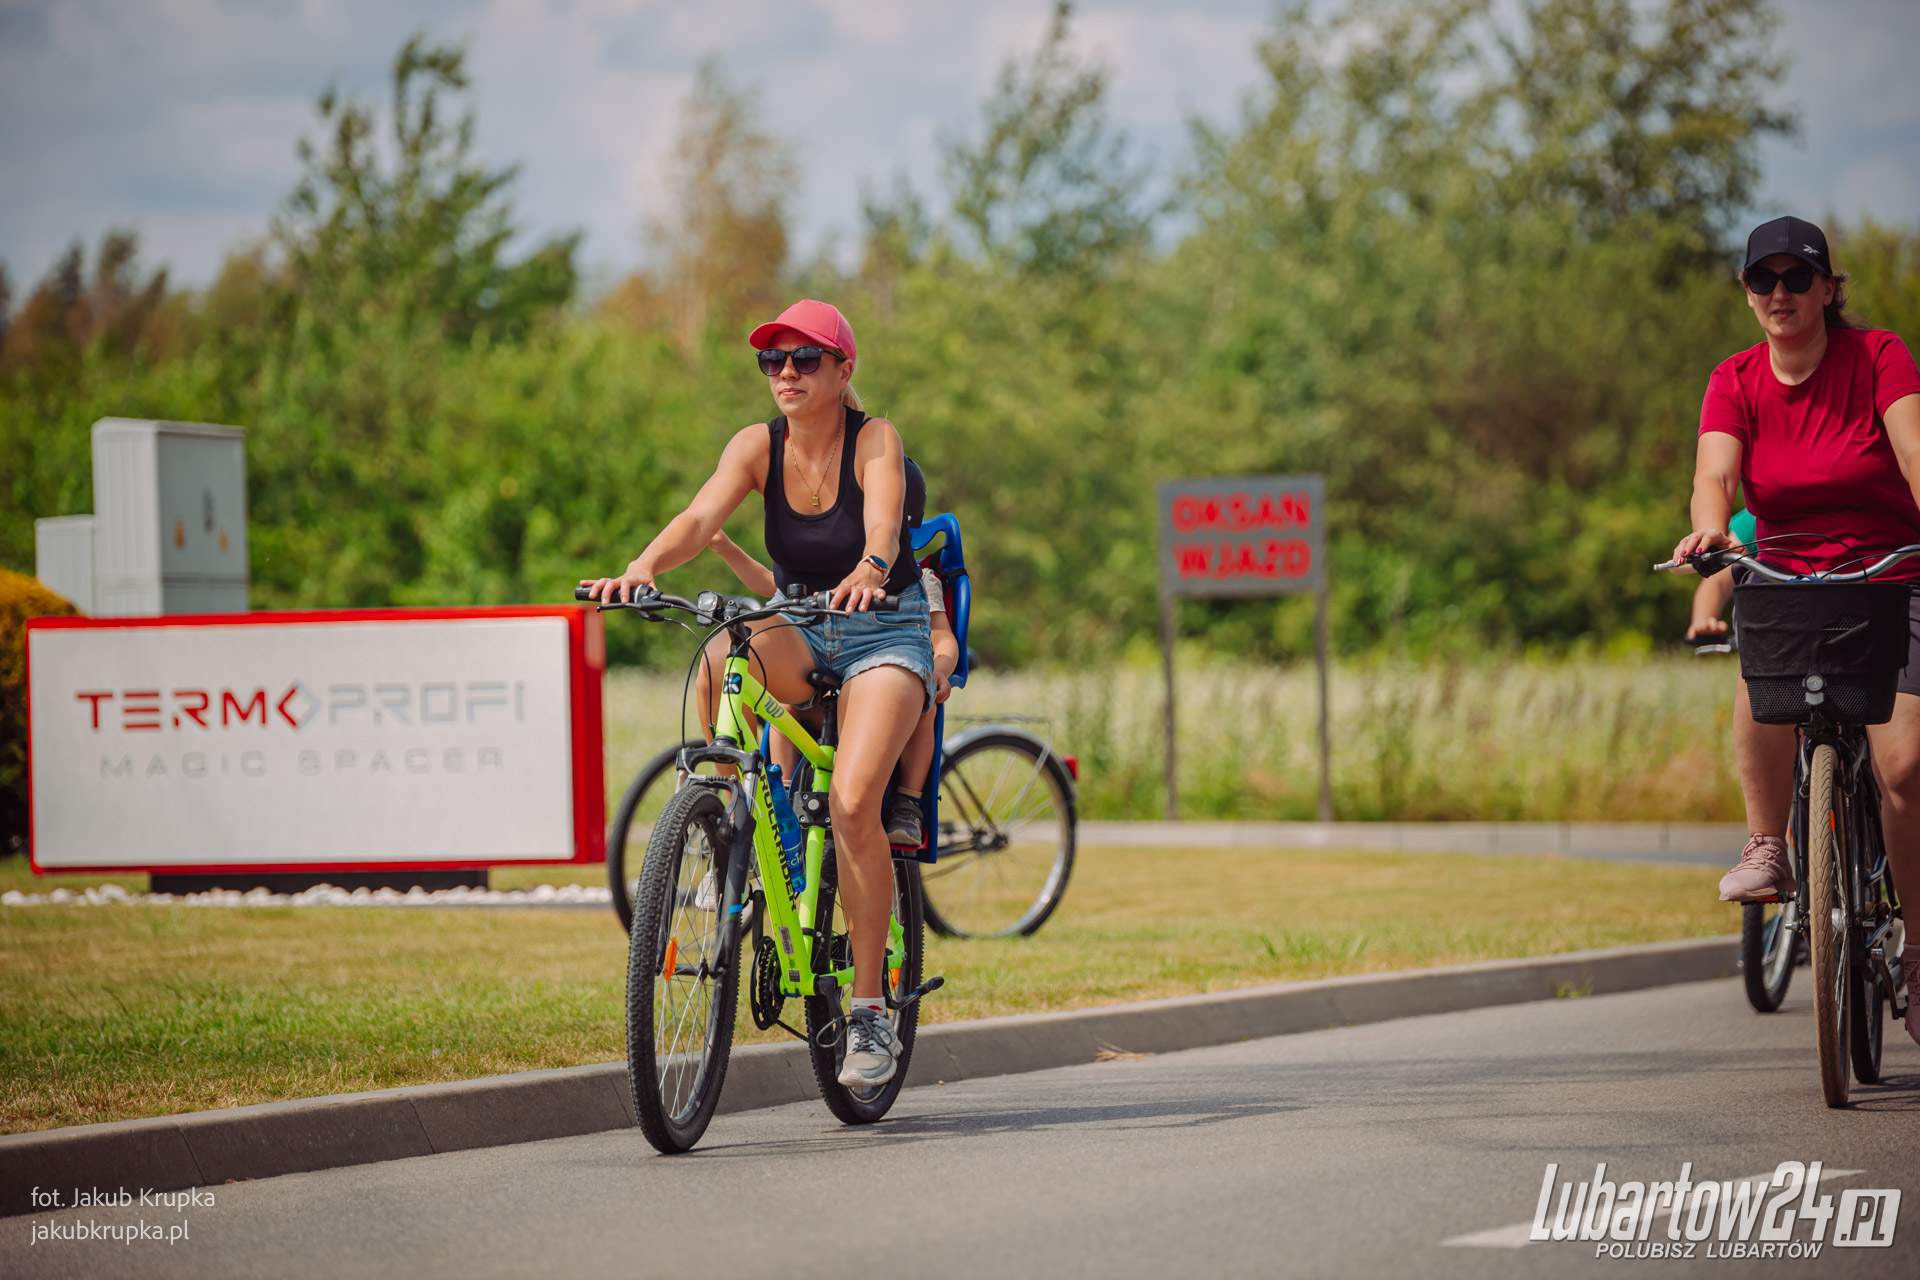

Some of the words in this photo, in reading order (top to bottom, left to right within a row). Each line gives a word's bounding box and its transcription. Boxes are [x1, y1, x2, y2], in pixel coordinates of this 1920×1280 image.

[1172, 492, 1310, 533] OKSAN
[1174, 538, 1312, 580] WJAZD
[100, 751, 267, 779] MAGIC
[298, 747, 503, 776] SPACER
